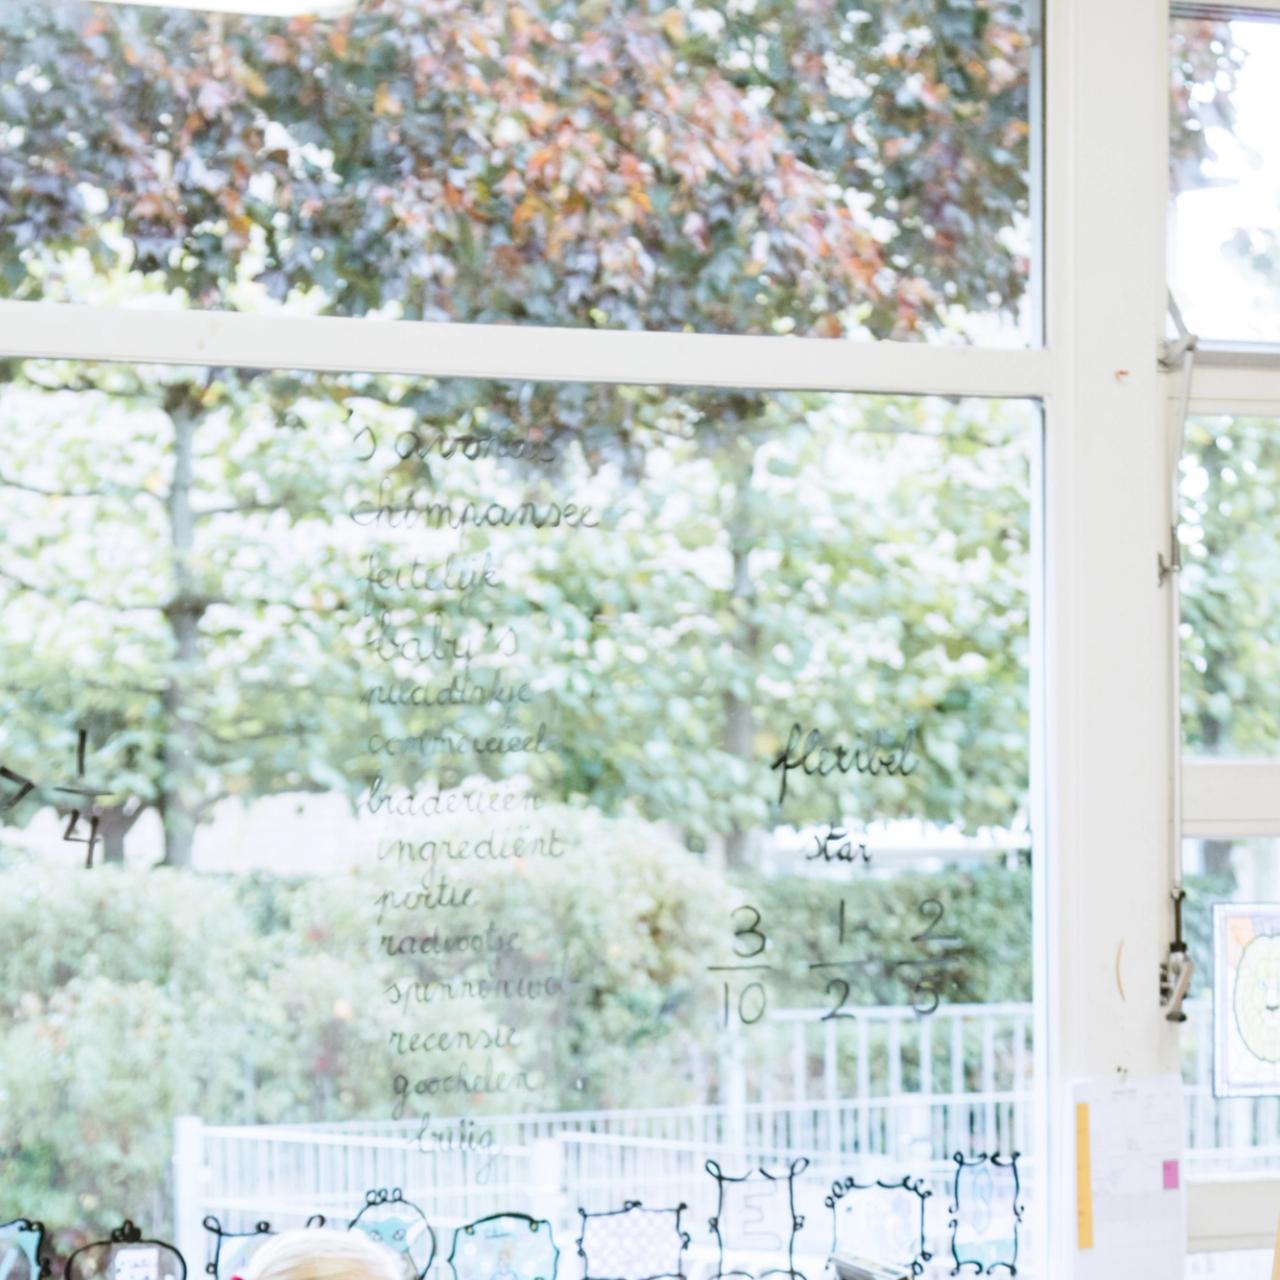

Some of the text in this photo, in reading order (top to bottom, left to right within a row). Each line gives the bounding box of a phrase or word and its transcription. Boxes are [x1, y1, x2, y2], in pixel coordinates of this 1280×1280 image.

[771, 722, 922, 806] flexibel
[63, 808, 104, 869] 4
[729, 904, 767, 958] 3
[909, 898, 960, 943] 2
[723, 980, 767, 1028] 10
[820, 978, 856, 1022] 2
[388, 1024, 522, 1055] recensie
